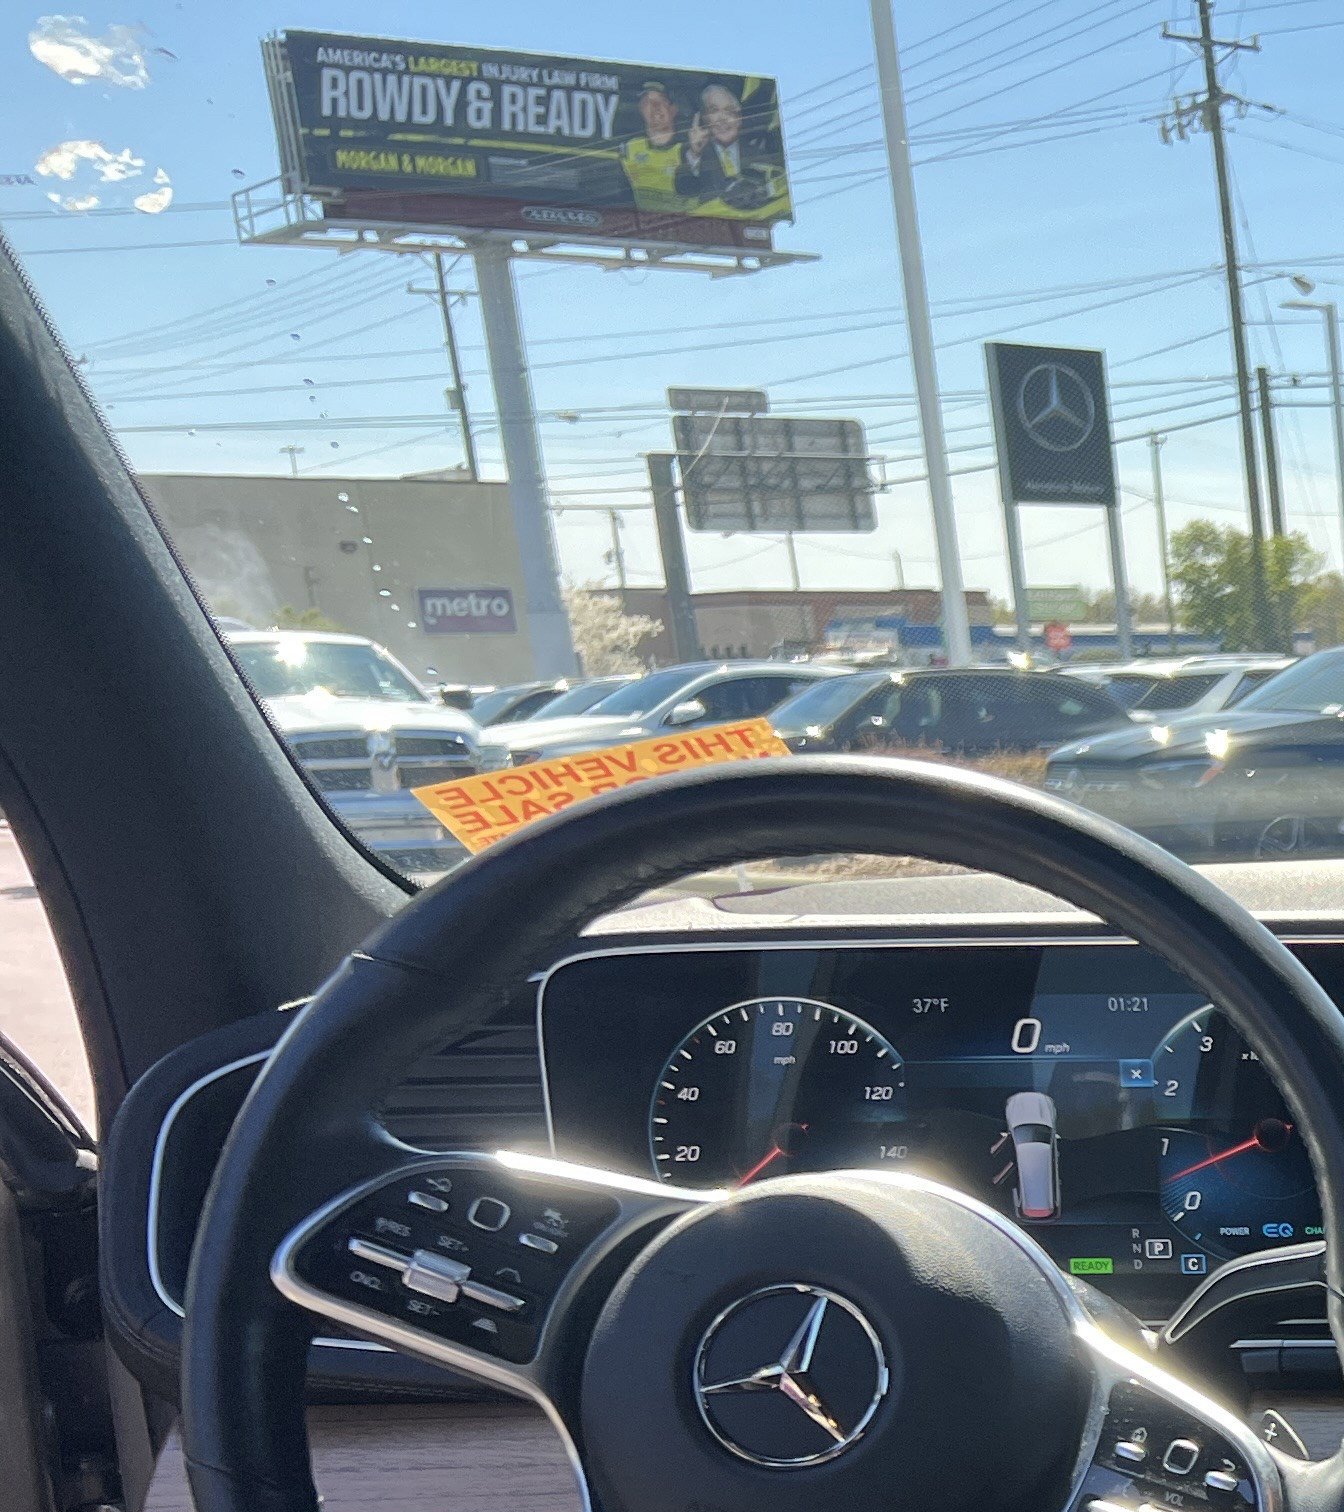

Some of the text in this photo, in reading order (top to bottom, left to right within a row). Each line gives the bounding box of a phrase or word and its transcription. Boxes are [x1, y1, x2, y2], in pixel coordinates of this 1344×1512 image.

[316, 46, 620, 91] AMERICA'S LARGEST INJURY LAW FIRM
[320, 65, 620, 141] ROWDY & READY
[336, 149, 478, 178] MORGAN & MORGAN
[424, 592, 511, 618] metro
[913, 997, 950, 1014] 37°F
[1107, 996, 1149, 1013] 01:21
[771, 1021, 794, 1036] 80
[1011, 1017, 1071, 1055] 0 mph
[714, 1040, 737, 1055] 60
[828, 1040, 858, 1055] 100
[1200, 1035, 1214, 1053] 3
[773, 1054, 796, 1066] mph
[677, 1087, 700, 1101] 40
[864, 1086, 894, 1101] 120
[1163, 1080, 1179, 1096] 2
[674, 1145, 700, 1162] 20
[879, 1145, 908, 1160] 140
[1160, 1137, 1171, 1156] 1
[1184, 1191, 1202, 1211] 0
[1131, 1228, 1141, 1240] R
[1219, 1226, 1251, 1237] POWER
[1132, 1243, 1142, 1254] N
[1153, 1242, 1165, 1256] P
[1072, 1260, 1111, 1271] READY
[1133, 1259, 1143, 1271] D
[1187, 1257, 1199, 1272] C
